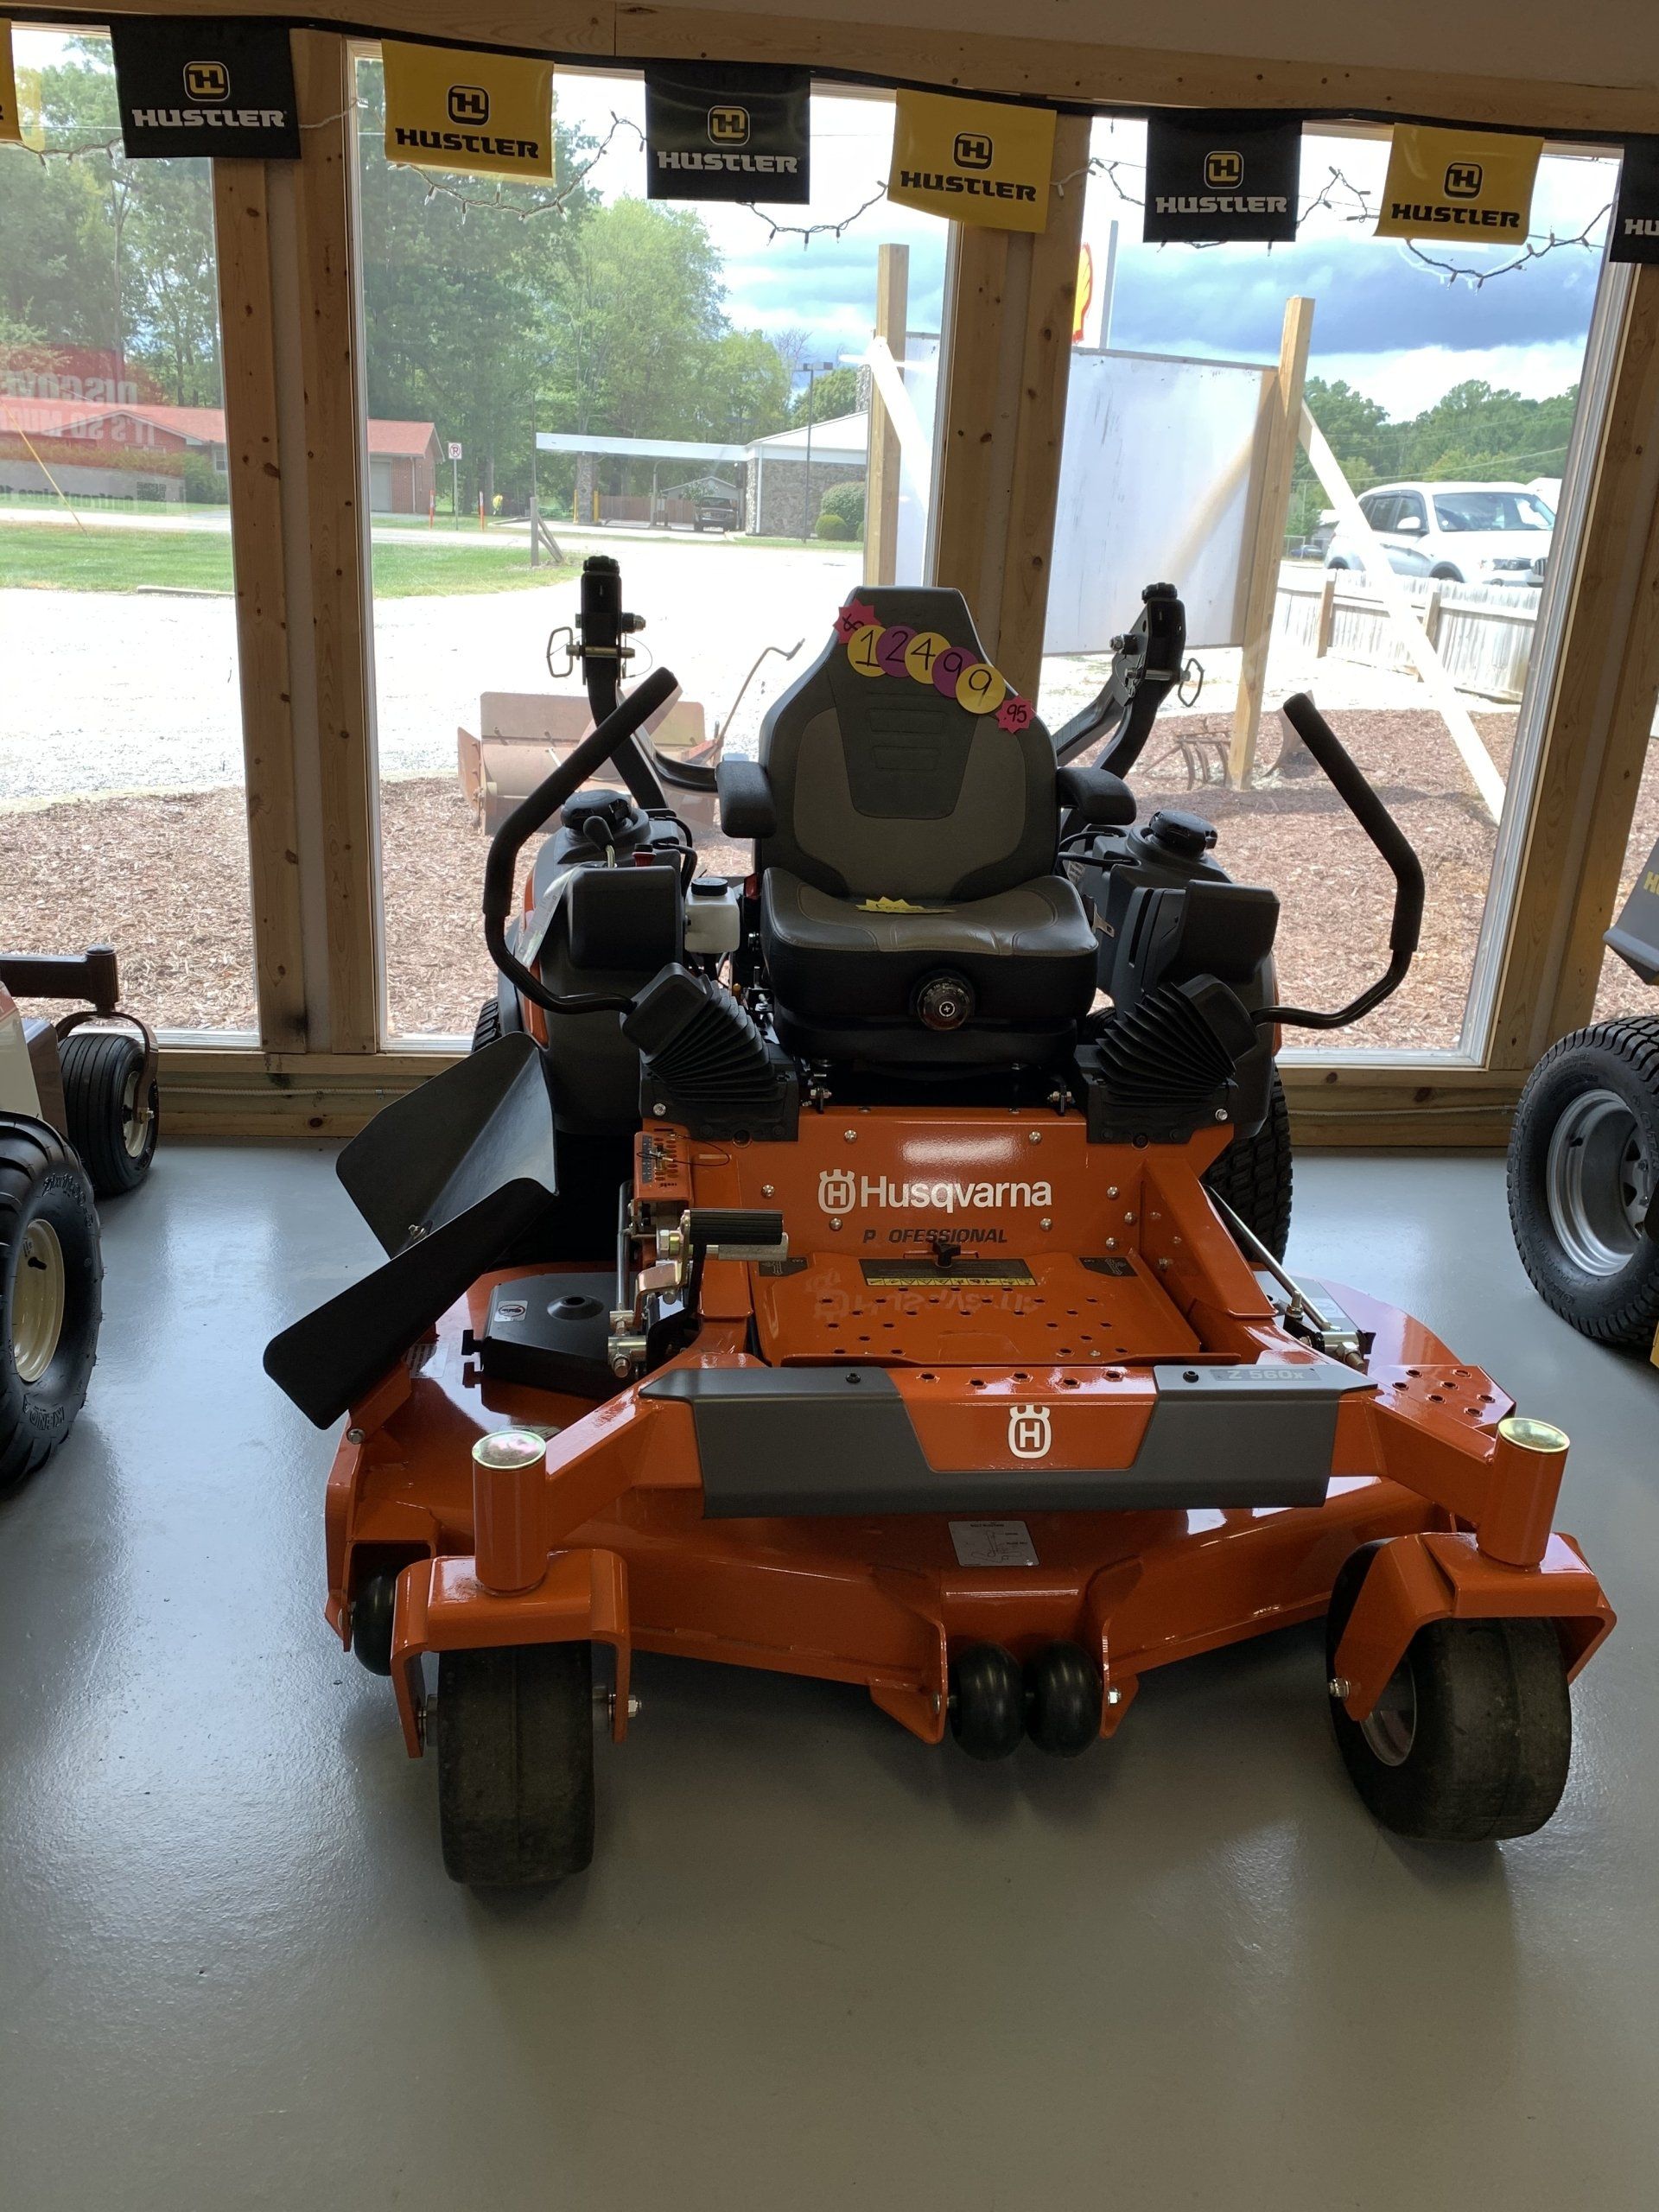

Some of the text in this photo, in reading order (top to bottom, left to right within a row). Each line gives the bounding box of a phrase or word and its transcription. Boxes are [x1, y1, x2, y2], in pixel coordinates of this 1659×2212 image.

[131, 108, 286, 129] HUSTLER
[395, 127, 539, 159] HUSTLER
[657, 150, 798, 174] HUSTLER
[900, 170, 1037, 202] HUSTLER
[1155, 195, 1287, 214] HUSTLER
[1391, 202, 1521, 228] HUSTLER
[860, 1175, 1052, 1213] Husqvarna
[863, 1229, 1007, 1243] POFESSIONAL
[1227, 1370, 1305, 1380] Z 560x
